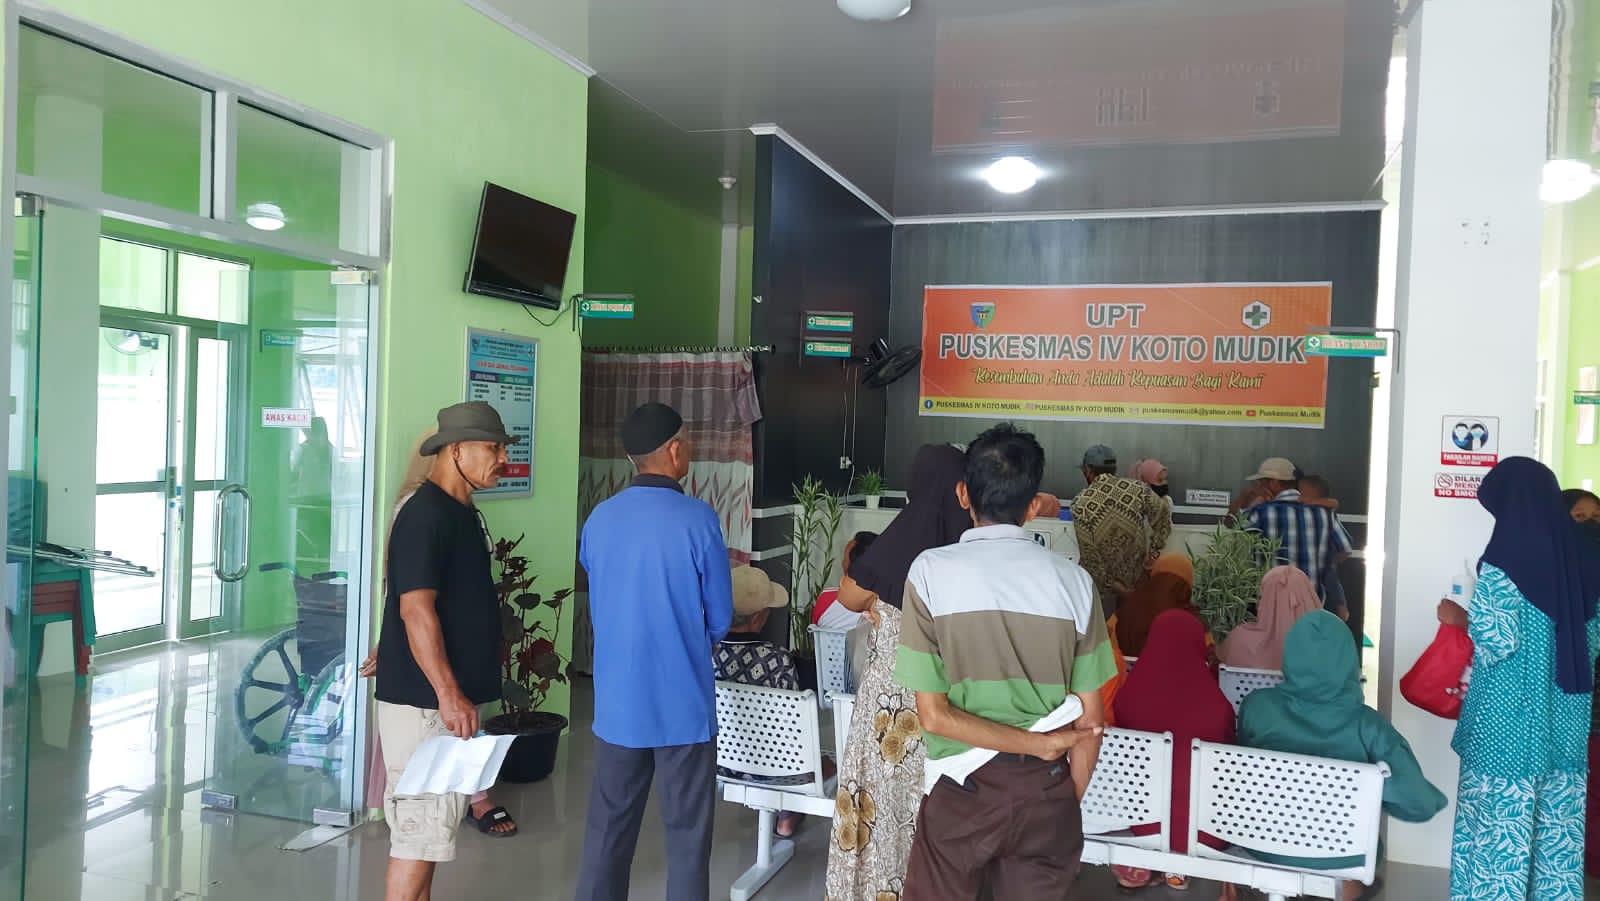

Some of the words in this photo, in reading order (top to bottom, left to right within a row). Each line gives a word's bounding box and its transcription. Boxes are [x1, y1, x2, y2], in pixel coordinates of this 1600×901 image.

[1086, 303, 1146, 328] UPT
[939, 333, 1092, 360] PUSKESMAS
[1098, 334, 1126, 361] IV
[1130, 335, 1207, 363] KOTO
[1213, 336, 1307, 364] MUDIK
[969, 367, 1044, 385] Kesembuhan
[1046, 369, 1080, 386] Anda
[1083, 370, 1124, 387] Adalah
[1129, 369, 1188, 390] Kepuasan
[1190, 371, 1224, 391] Bagi
[1226, 372, 1265, 389] Kami
[936, 401, 973, 409] PUSKESMAS
[1000, 403, 1021, 411] MUDIK
[1034, 403, 1074, 412] PUSKESMAS
[1083, 405, 1102, 413] KOTO
[1103, 406, 1125, 414] MUDIK
[265, 413, 285, 422] AWAS
[1259, 410, 1298, 418] Puskesmas
[1454, 489, 1478, 497] SMO
